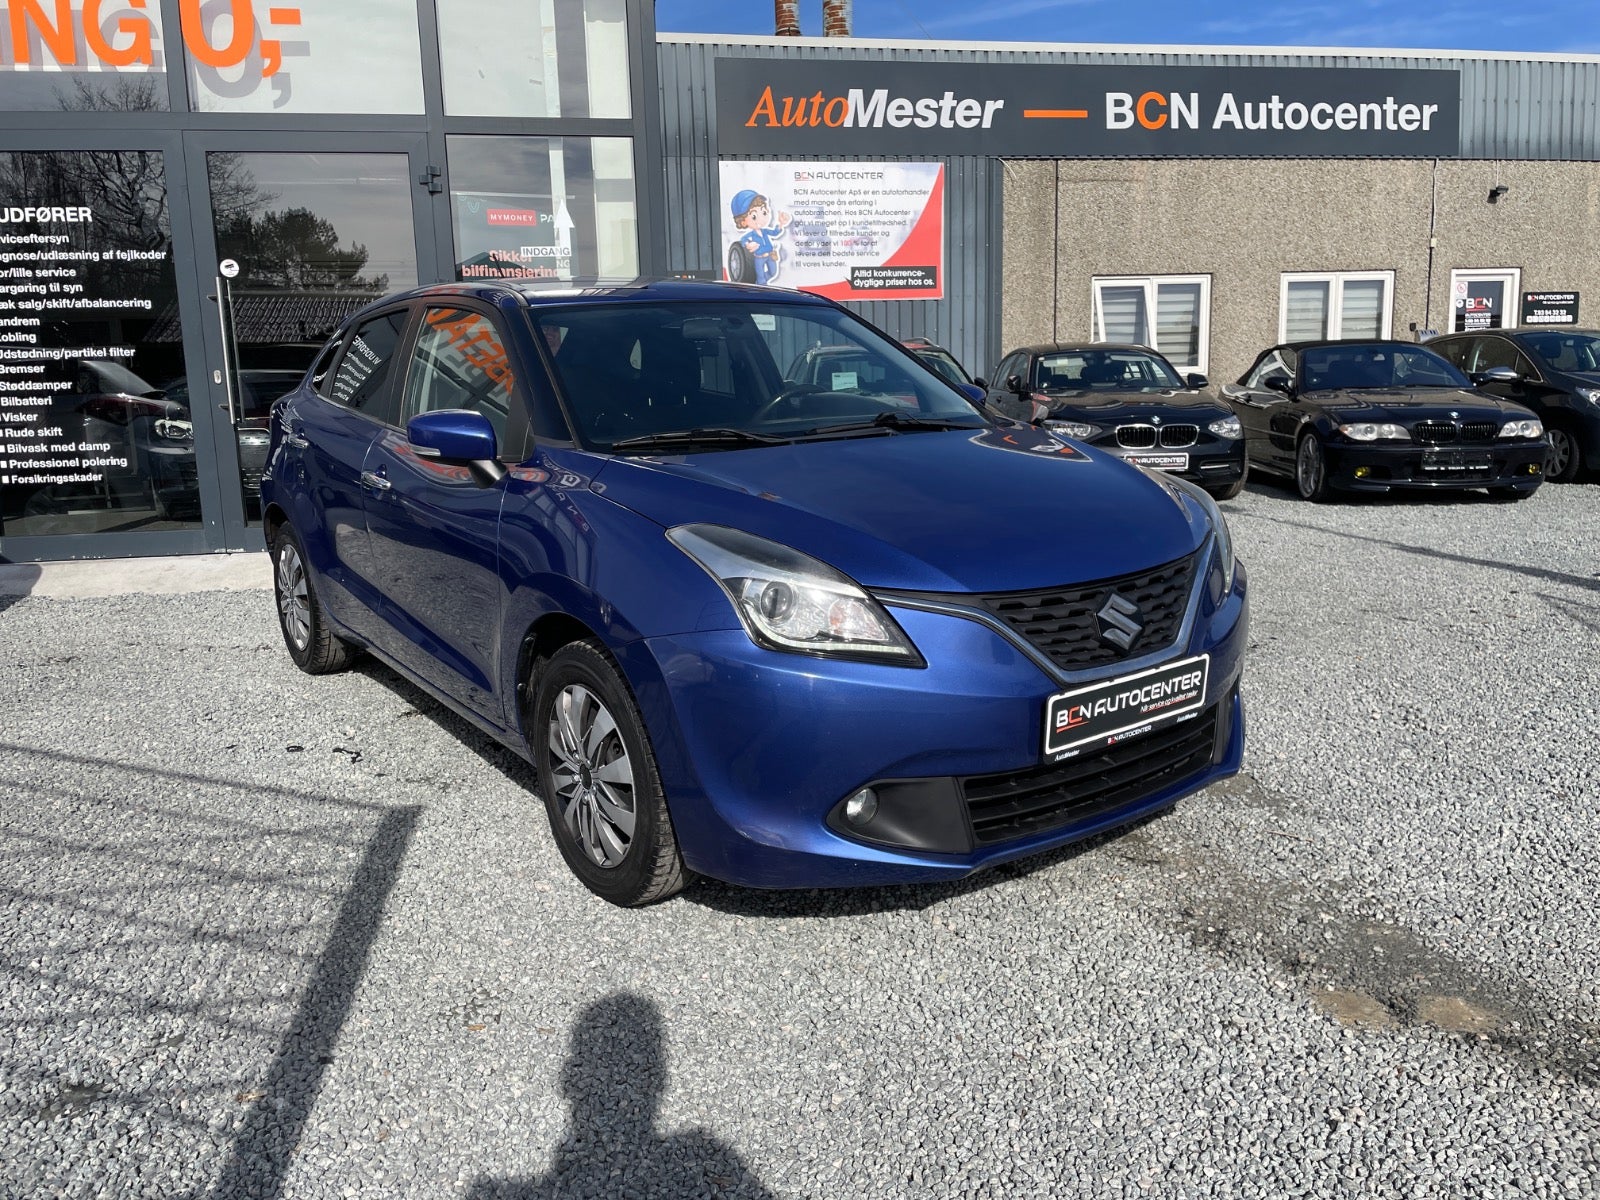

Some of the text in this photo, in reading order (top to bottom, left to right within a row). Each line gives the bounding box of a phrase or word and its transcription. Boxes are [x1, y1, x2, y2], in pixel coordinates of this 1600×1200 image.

[745, 85, 1438, 131] AutoMester BCN Autocenter
[794, 171, 884, 180] BCN AUTOCENTER
[793, 188, 809, 196] BCN
[810, 188, 847, 196] Autocenter
[881, 188, 929, 196] autoforhandler
[811, 200, 836, 208] mange
[848, 199, 874, 208] erfaring
[0, 206, 93, 223] UDFØRER
[490, 213, 533, 222] MYMONEY
[845, 209, 857, 217] Hos
[858, 209, 873, 217] BCN
[873, 209, 911, 217] Autocenter
[815, 219, 837, 228] meget
[838, 219, 848, 227] op
[0, 233, 70, 245] viceeftersyn
[102, 250, 114, 260] af
[116, 250, 167, 262] fejlkoder
[523, 247, 571, 256] INDGANG
[35, 268, 77, 278] service
[854, 269, 872, 278] Altid
[49, 282, 61, 293] til
[63, 284, 83, 294] syn
[853, 278, 935, 287] dygtige priser hos os.
[18, 298, 152, 311] salg/skift/afbalancering
[1465, 297, 1493, 309] BCN
[0, 332, 37, 343] obling
[109, 347, 135, 358] filter
[0, 364, 46, 375] Bremser
[1, 396, 52, 406] Bilbatteri
[2, 412, 39, 422] Visker
[5, 427, 63, 438] Rude skift
[7, 441, 111, 454] Bilvask med damp
[9, 456, 128, 469] Professionel polering
[1141, 456, 1186, 464] AUTOCENTER
[11, 473, 103, 485] Forsikringsskader
[1056, 670, 1202, 728] BCN AUTOCENTER
[1118, 725, 1152, 741] AUTOCENTER
